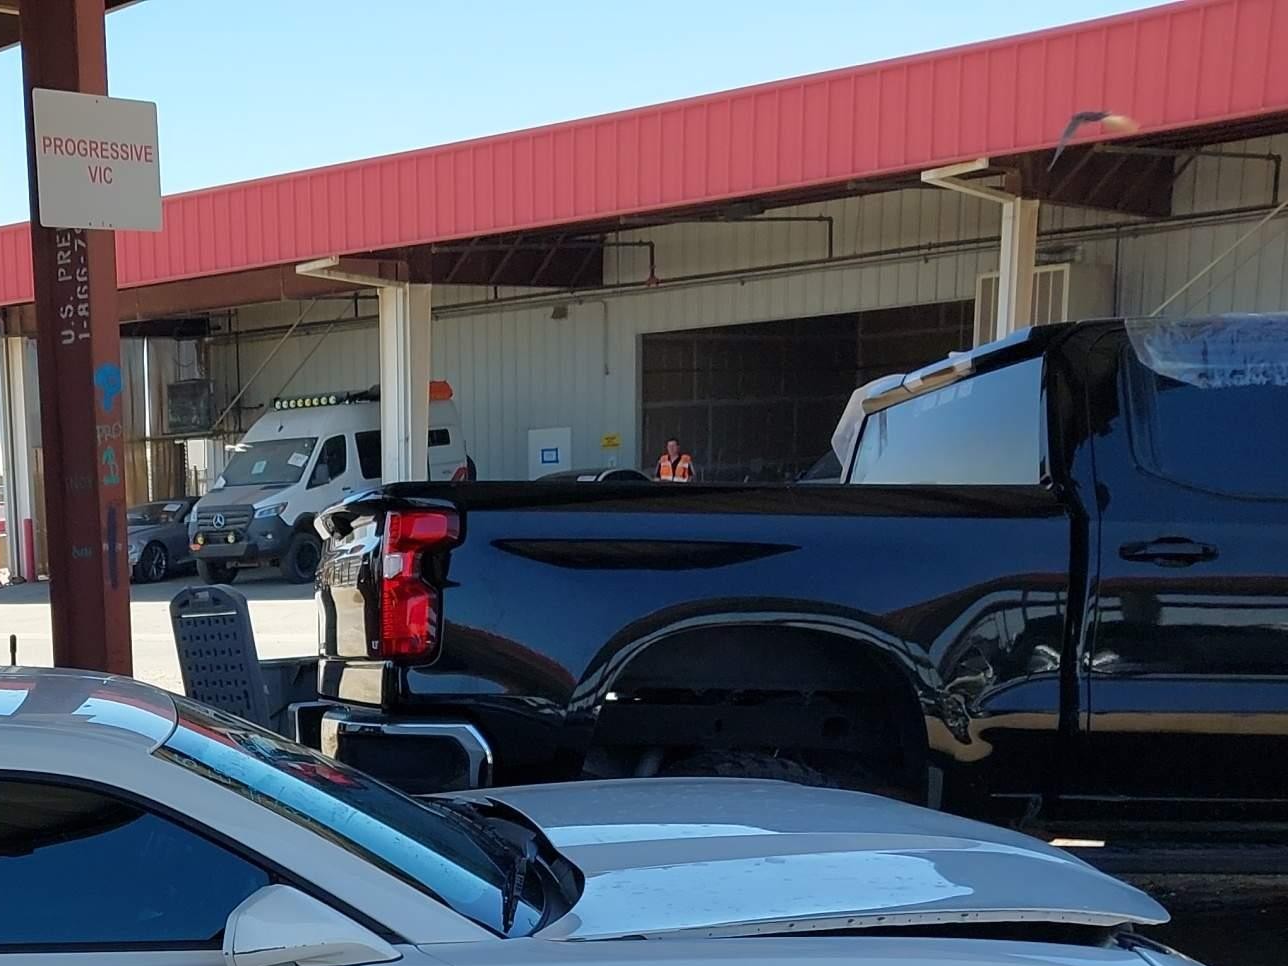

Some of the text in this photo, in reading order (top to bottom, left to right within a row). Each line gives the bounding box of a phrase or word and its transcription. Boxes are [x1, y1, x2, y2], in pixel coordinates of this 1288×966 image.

[42, 136, 153, 163] PROGRESSIVE
[88, 165, 113, 184] VIC
[56, 228, 75, 344] U.S. PRE
